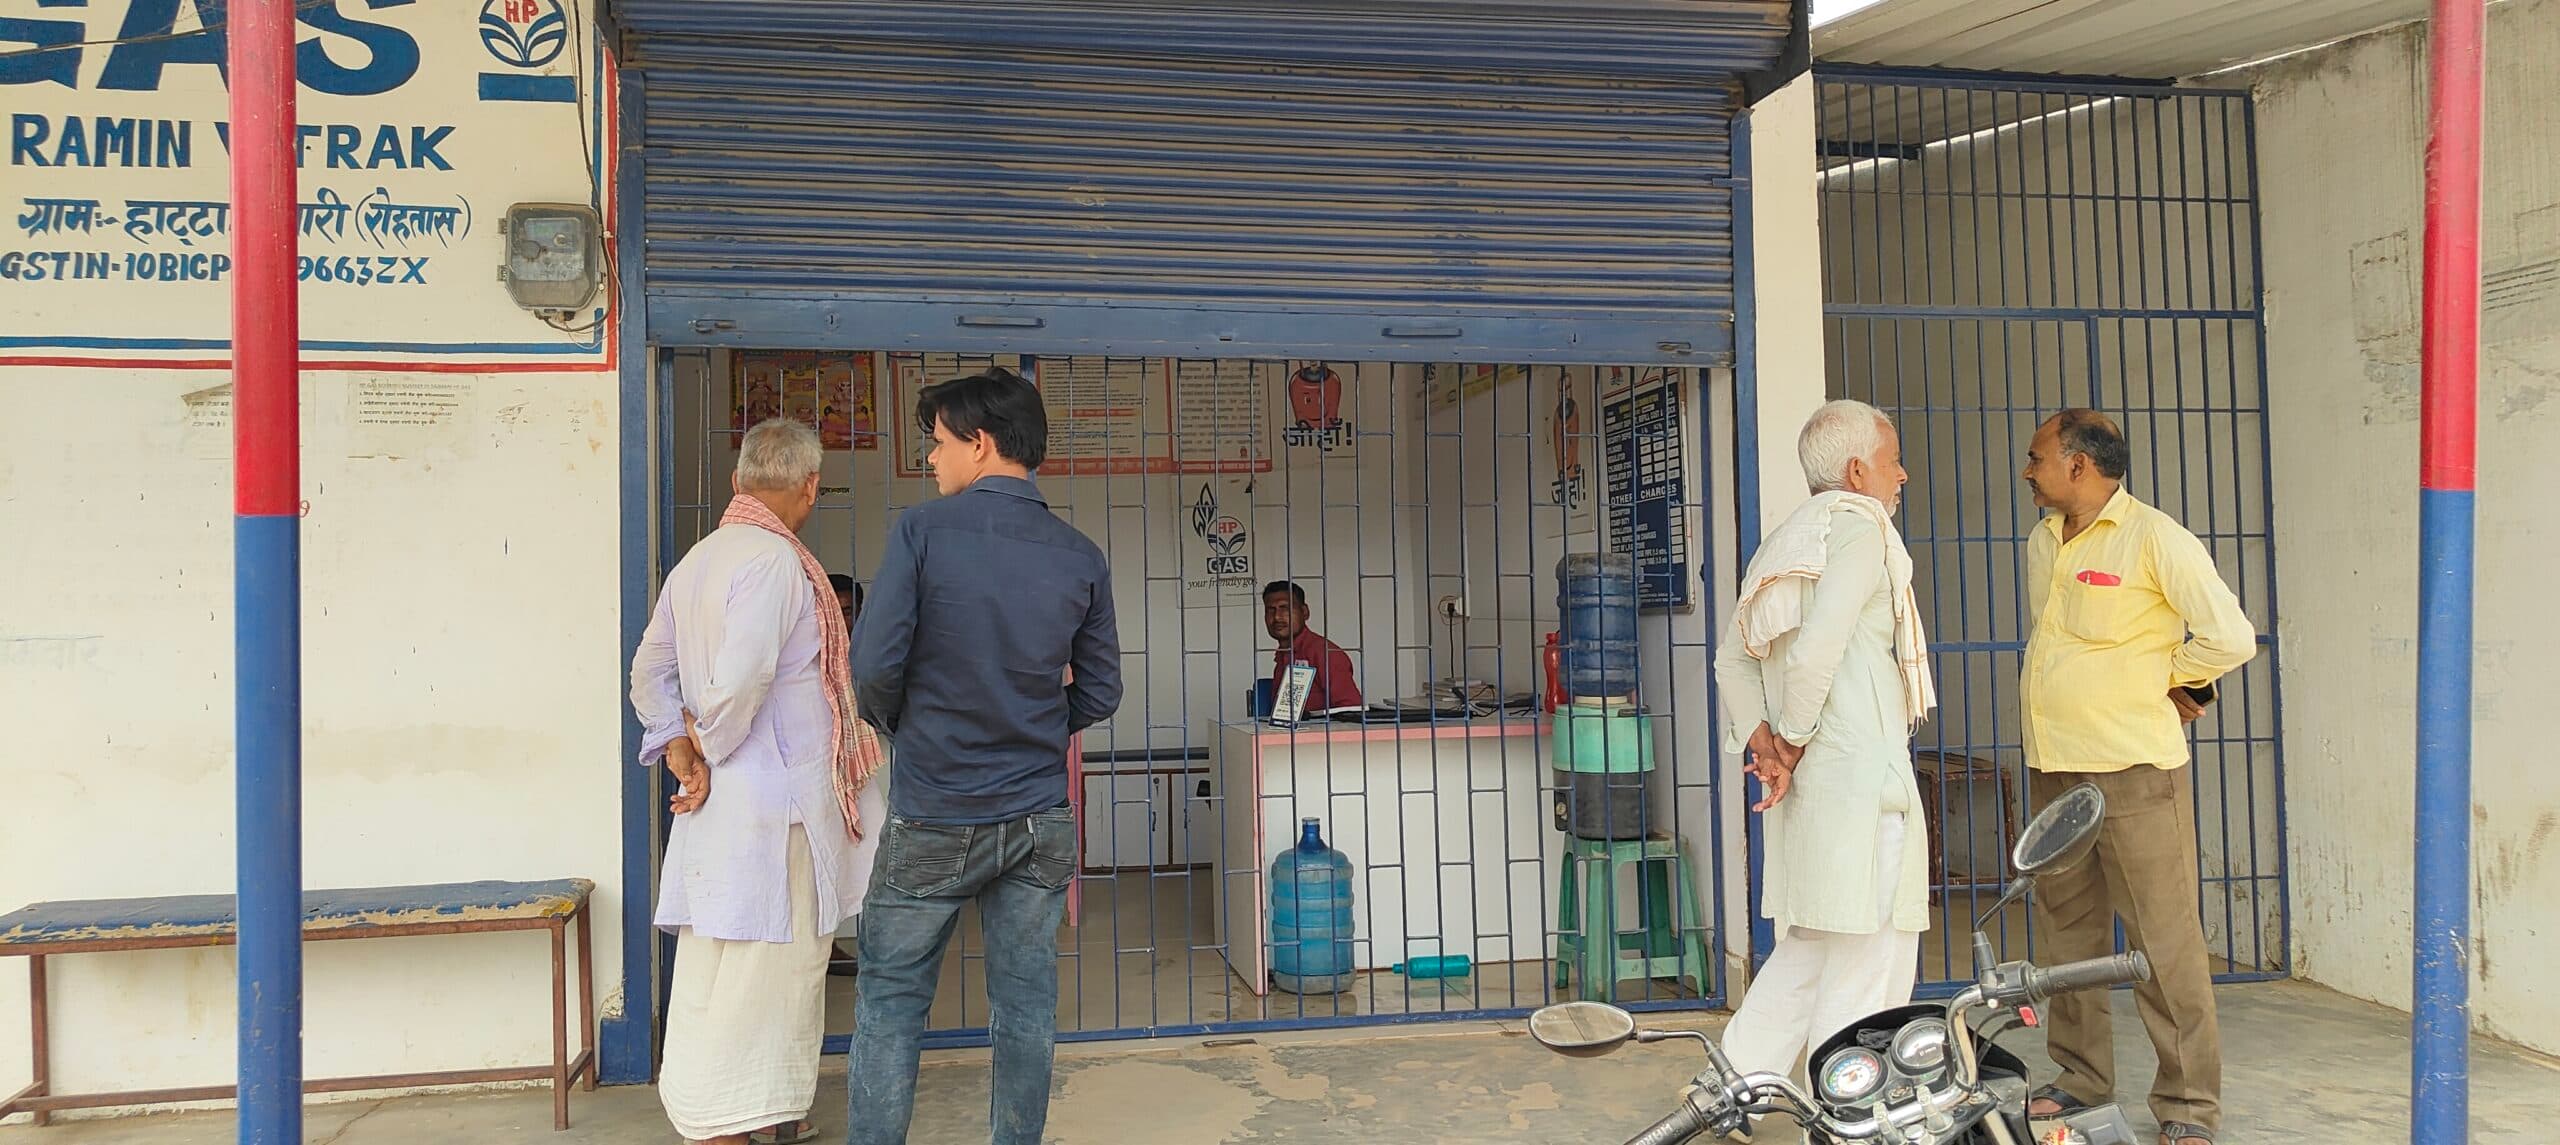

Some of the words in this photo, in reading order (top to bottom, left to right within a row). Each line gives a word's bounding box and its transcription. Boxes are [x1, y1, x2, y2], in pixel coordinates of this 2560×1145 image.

[504, 0, 539, 24] HP
[11, 112, 192, 168] RAMIN
[355, 186, 472, 249] (रोहतास)
[1217, 521, 1239, 534] HP
[1208, 557, 1247, 573] GAS
[1187, 580, 1208, 590] your
